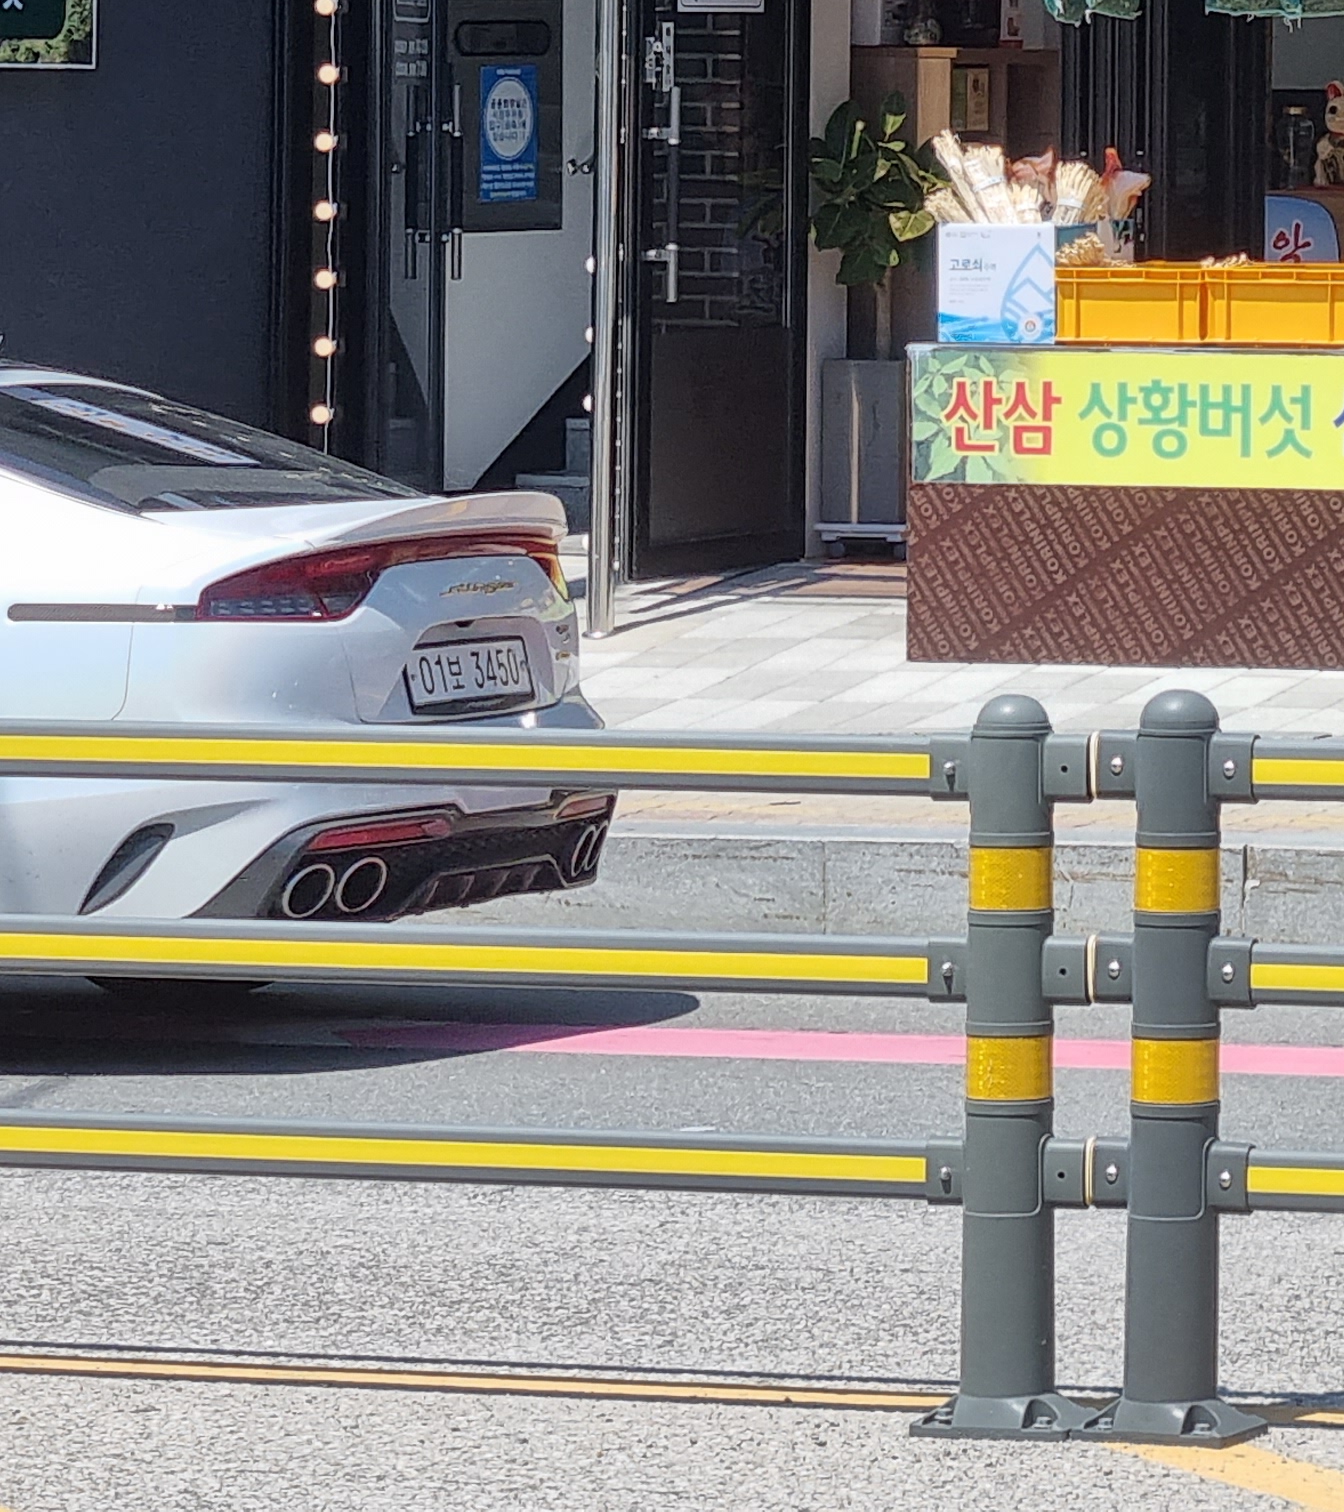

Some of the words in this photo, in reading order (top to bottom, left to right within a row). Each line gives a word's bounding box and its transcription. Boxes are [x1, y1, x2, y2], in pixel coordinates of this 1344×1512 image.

[949, 257, 982, 272] 고로쇠
[942, 379, 1062, 457] 산삼
[1078, 379, 1313, 461] 상황버섯
[419, 654, 465, 695] 01보
[469, 648, 520, 690] 3450
